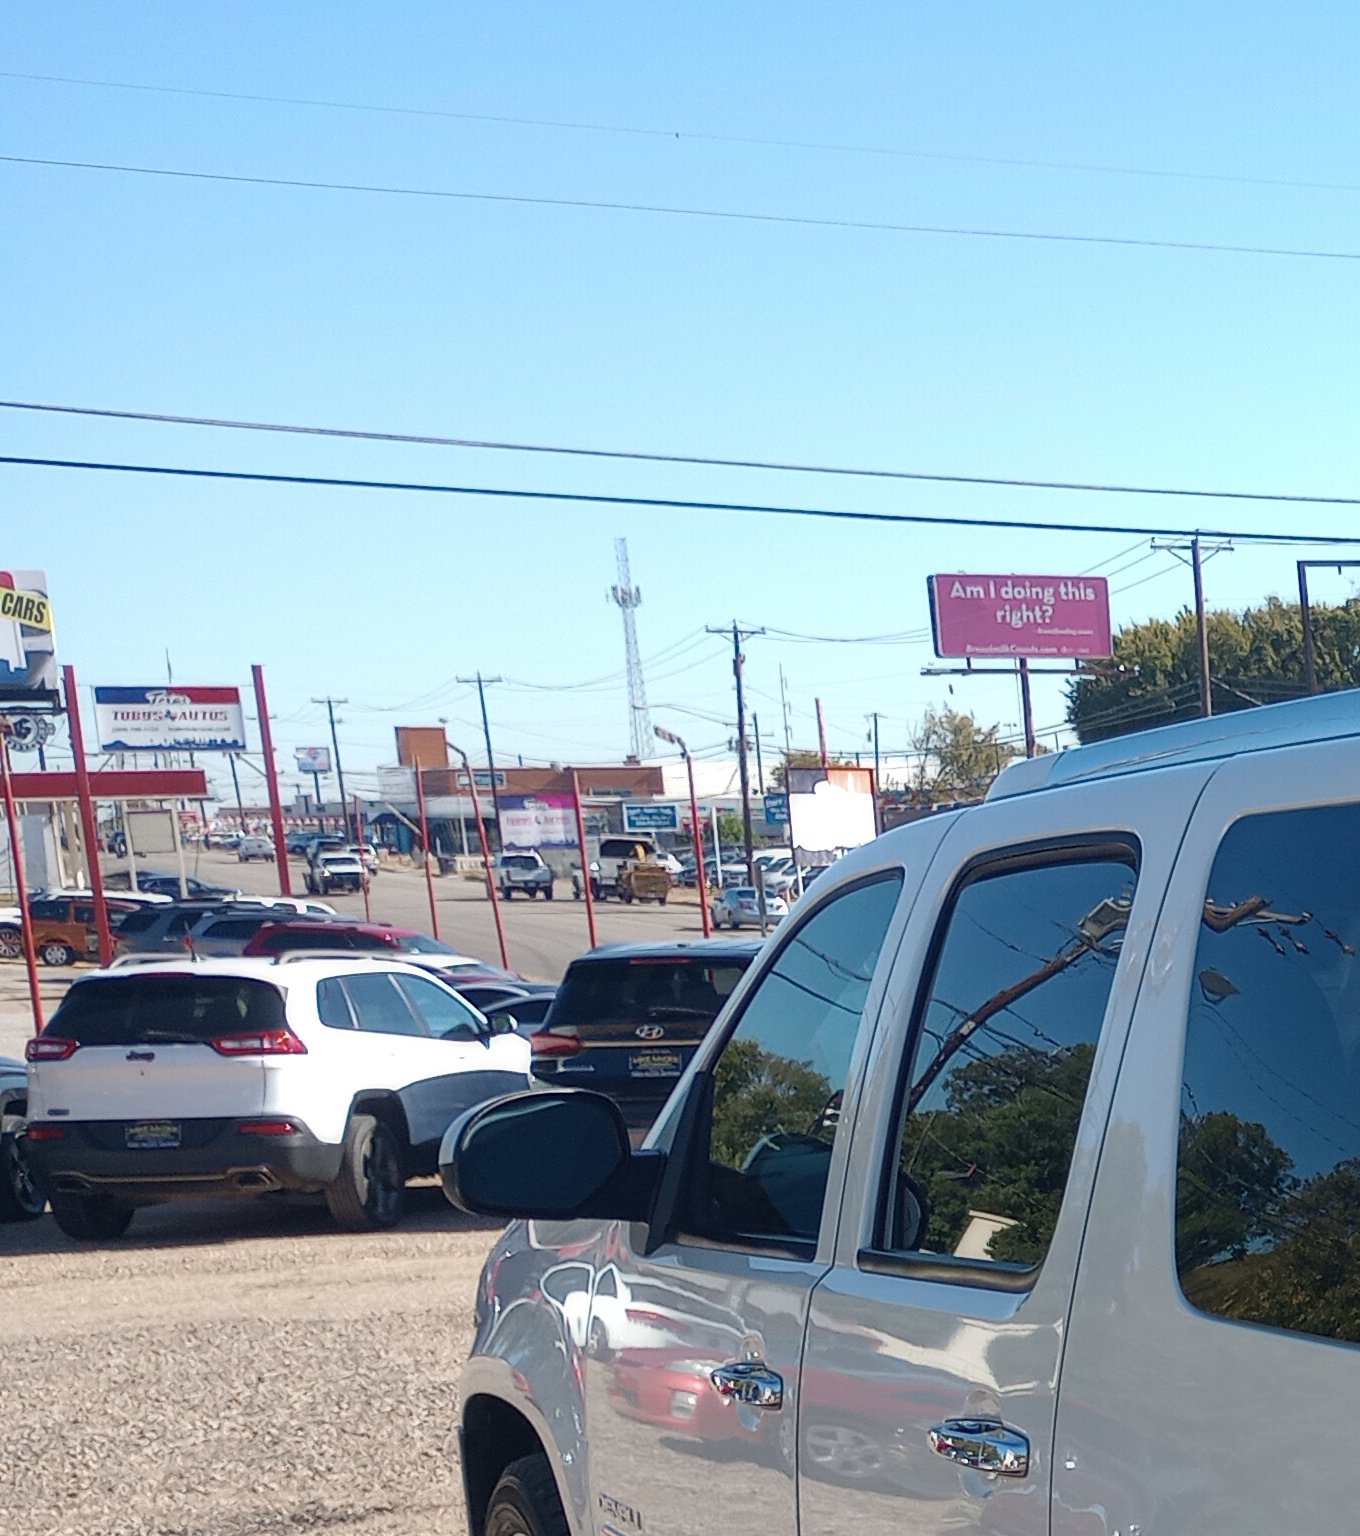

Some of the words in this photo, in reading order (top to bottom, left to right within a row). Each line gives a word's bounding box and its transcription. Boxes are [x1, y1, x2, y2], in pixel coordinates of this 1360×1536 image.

[950, 580, 985, 599] Am
[989, 580, 996, 599] I
[1000, 580, 1055, 604] doing
[1058, 581, 1096, 600] this
[1, 592, 46, 625] CARS
[995, 603, 1054, 628] right?
